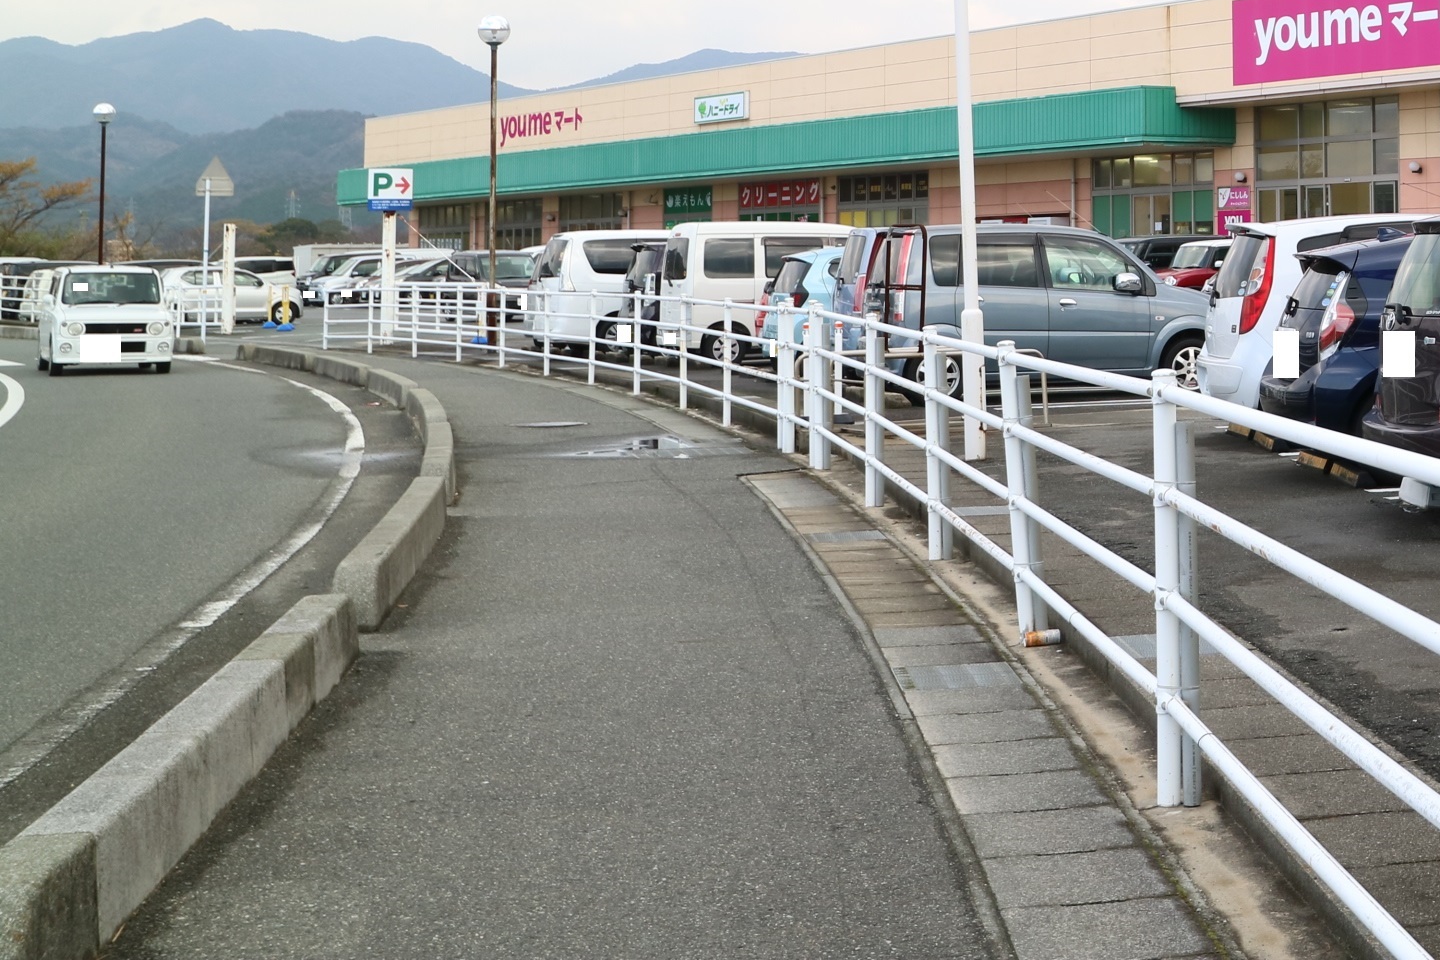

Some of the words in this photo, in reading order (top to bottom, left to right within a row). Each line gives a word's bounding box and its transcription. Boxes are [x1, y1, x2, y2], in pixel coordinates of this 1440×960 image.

[1254, 4, 1382, 66] youme
[707, 103, 741, 117] ハニードライ
[500, 112, 552, 147] youme
[554, 108, 583, 132] マート
[373, 172, 393, 197] P
[742, 182, 820, 206] クリーニング
[674, 193, 705, 208] 楽えもん
